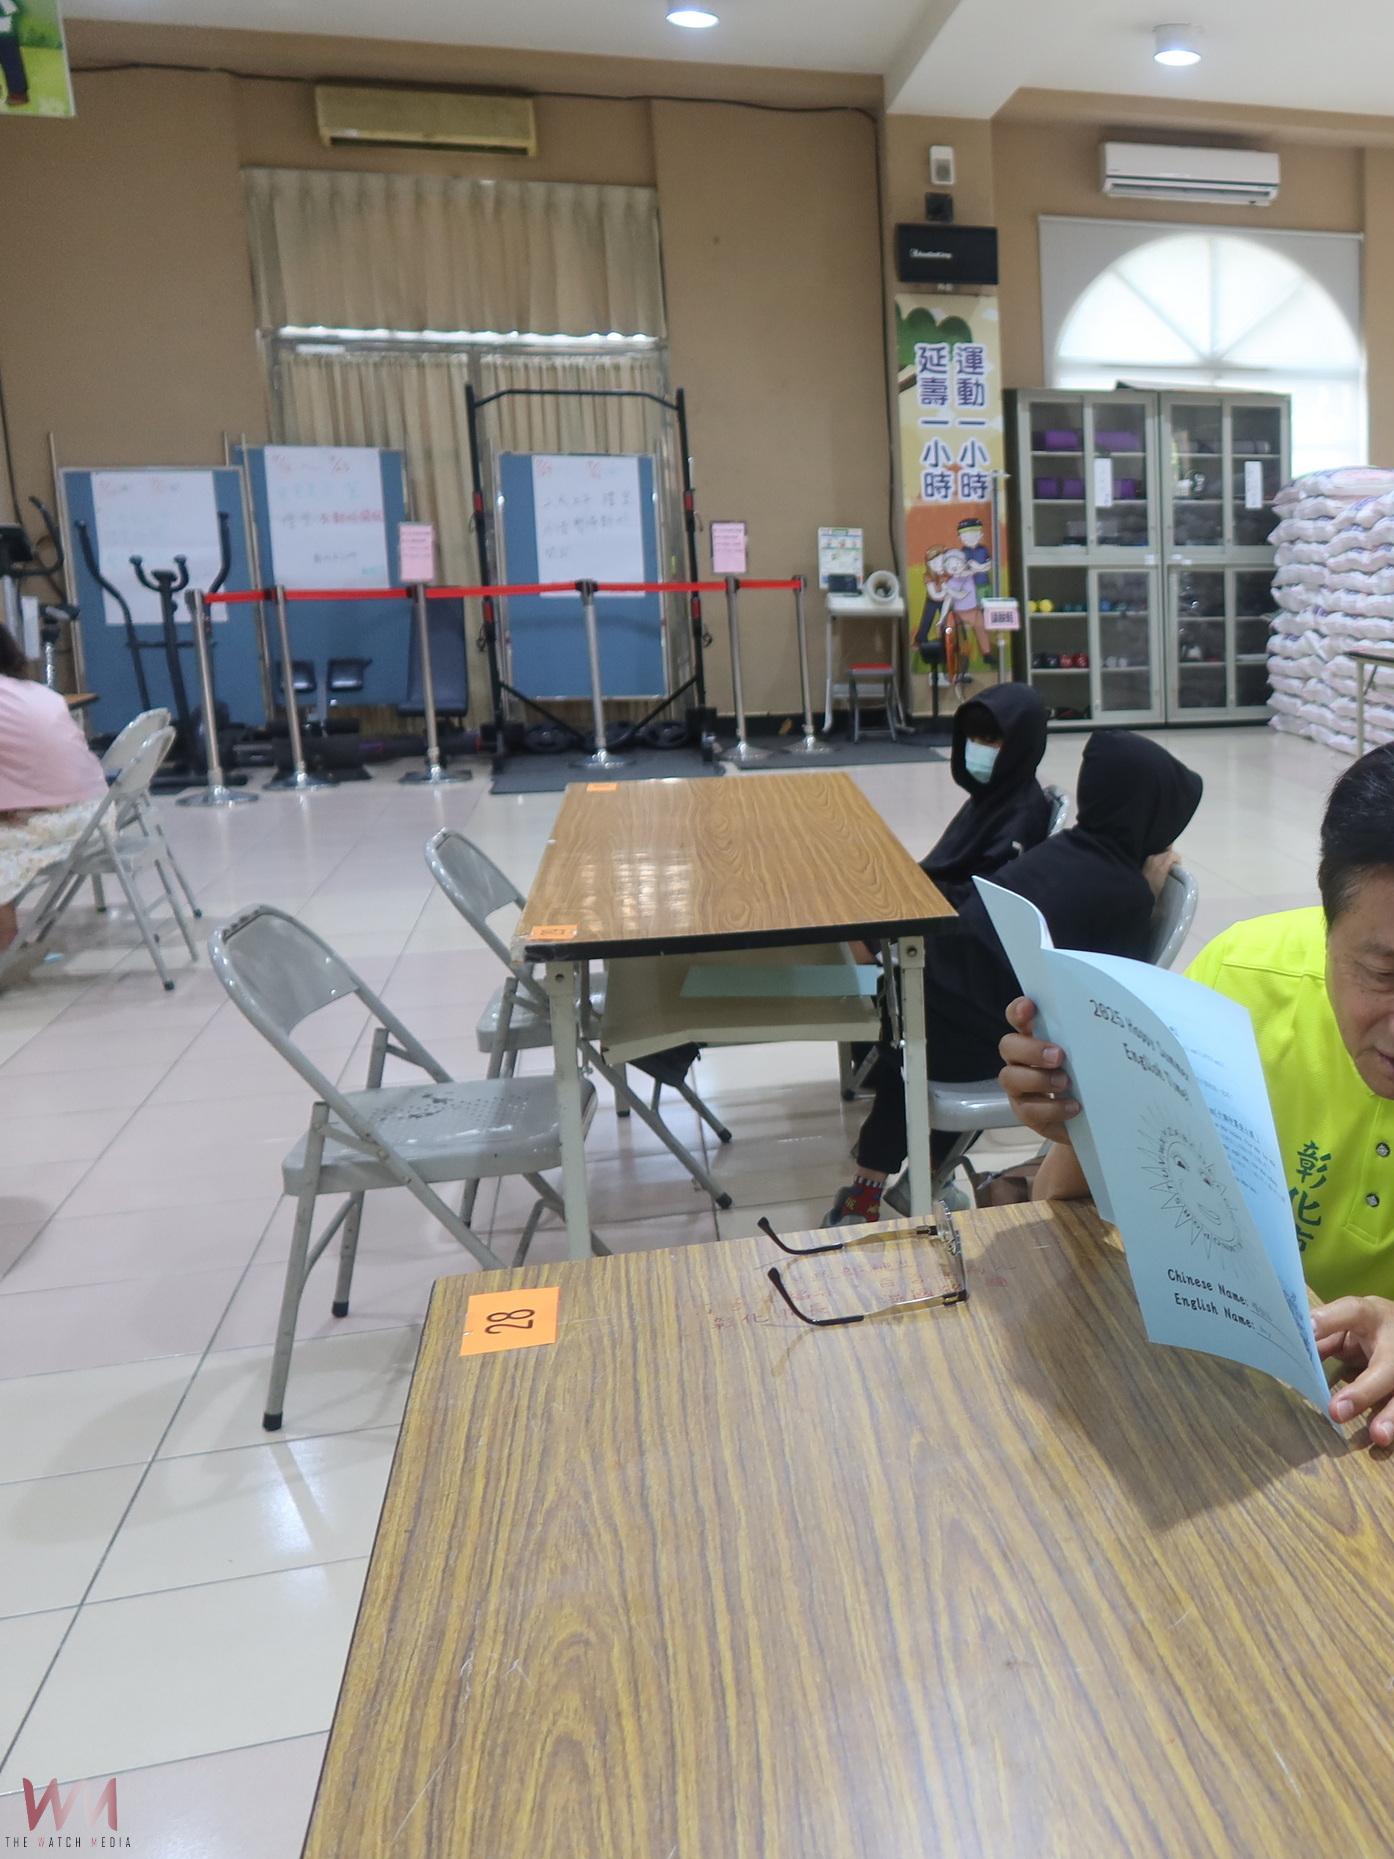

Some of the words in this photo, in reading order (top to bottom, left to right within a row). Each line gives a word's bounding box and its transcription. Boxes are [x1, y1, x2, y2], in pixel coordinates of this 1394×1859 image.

[917, 345, 952, 500] 延壽一小時
[955, 345, 989, 500] 運動一小時
[1089, 999, 1125, 1029] 2025
[1167, 1268, 1213, 1292] Chinese
[1217, 1283, 1249, 1307] Name:
[484, 1308, 536, 1335] 28
[1174, 1292, 1219, 1316] English
[1223, 1306, 1256, 1330] Name:
